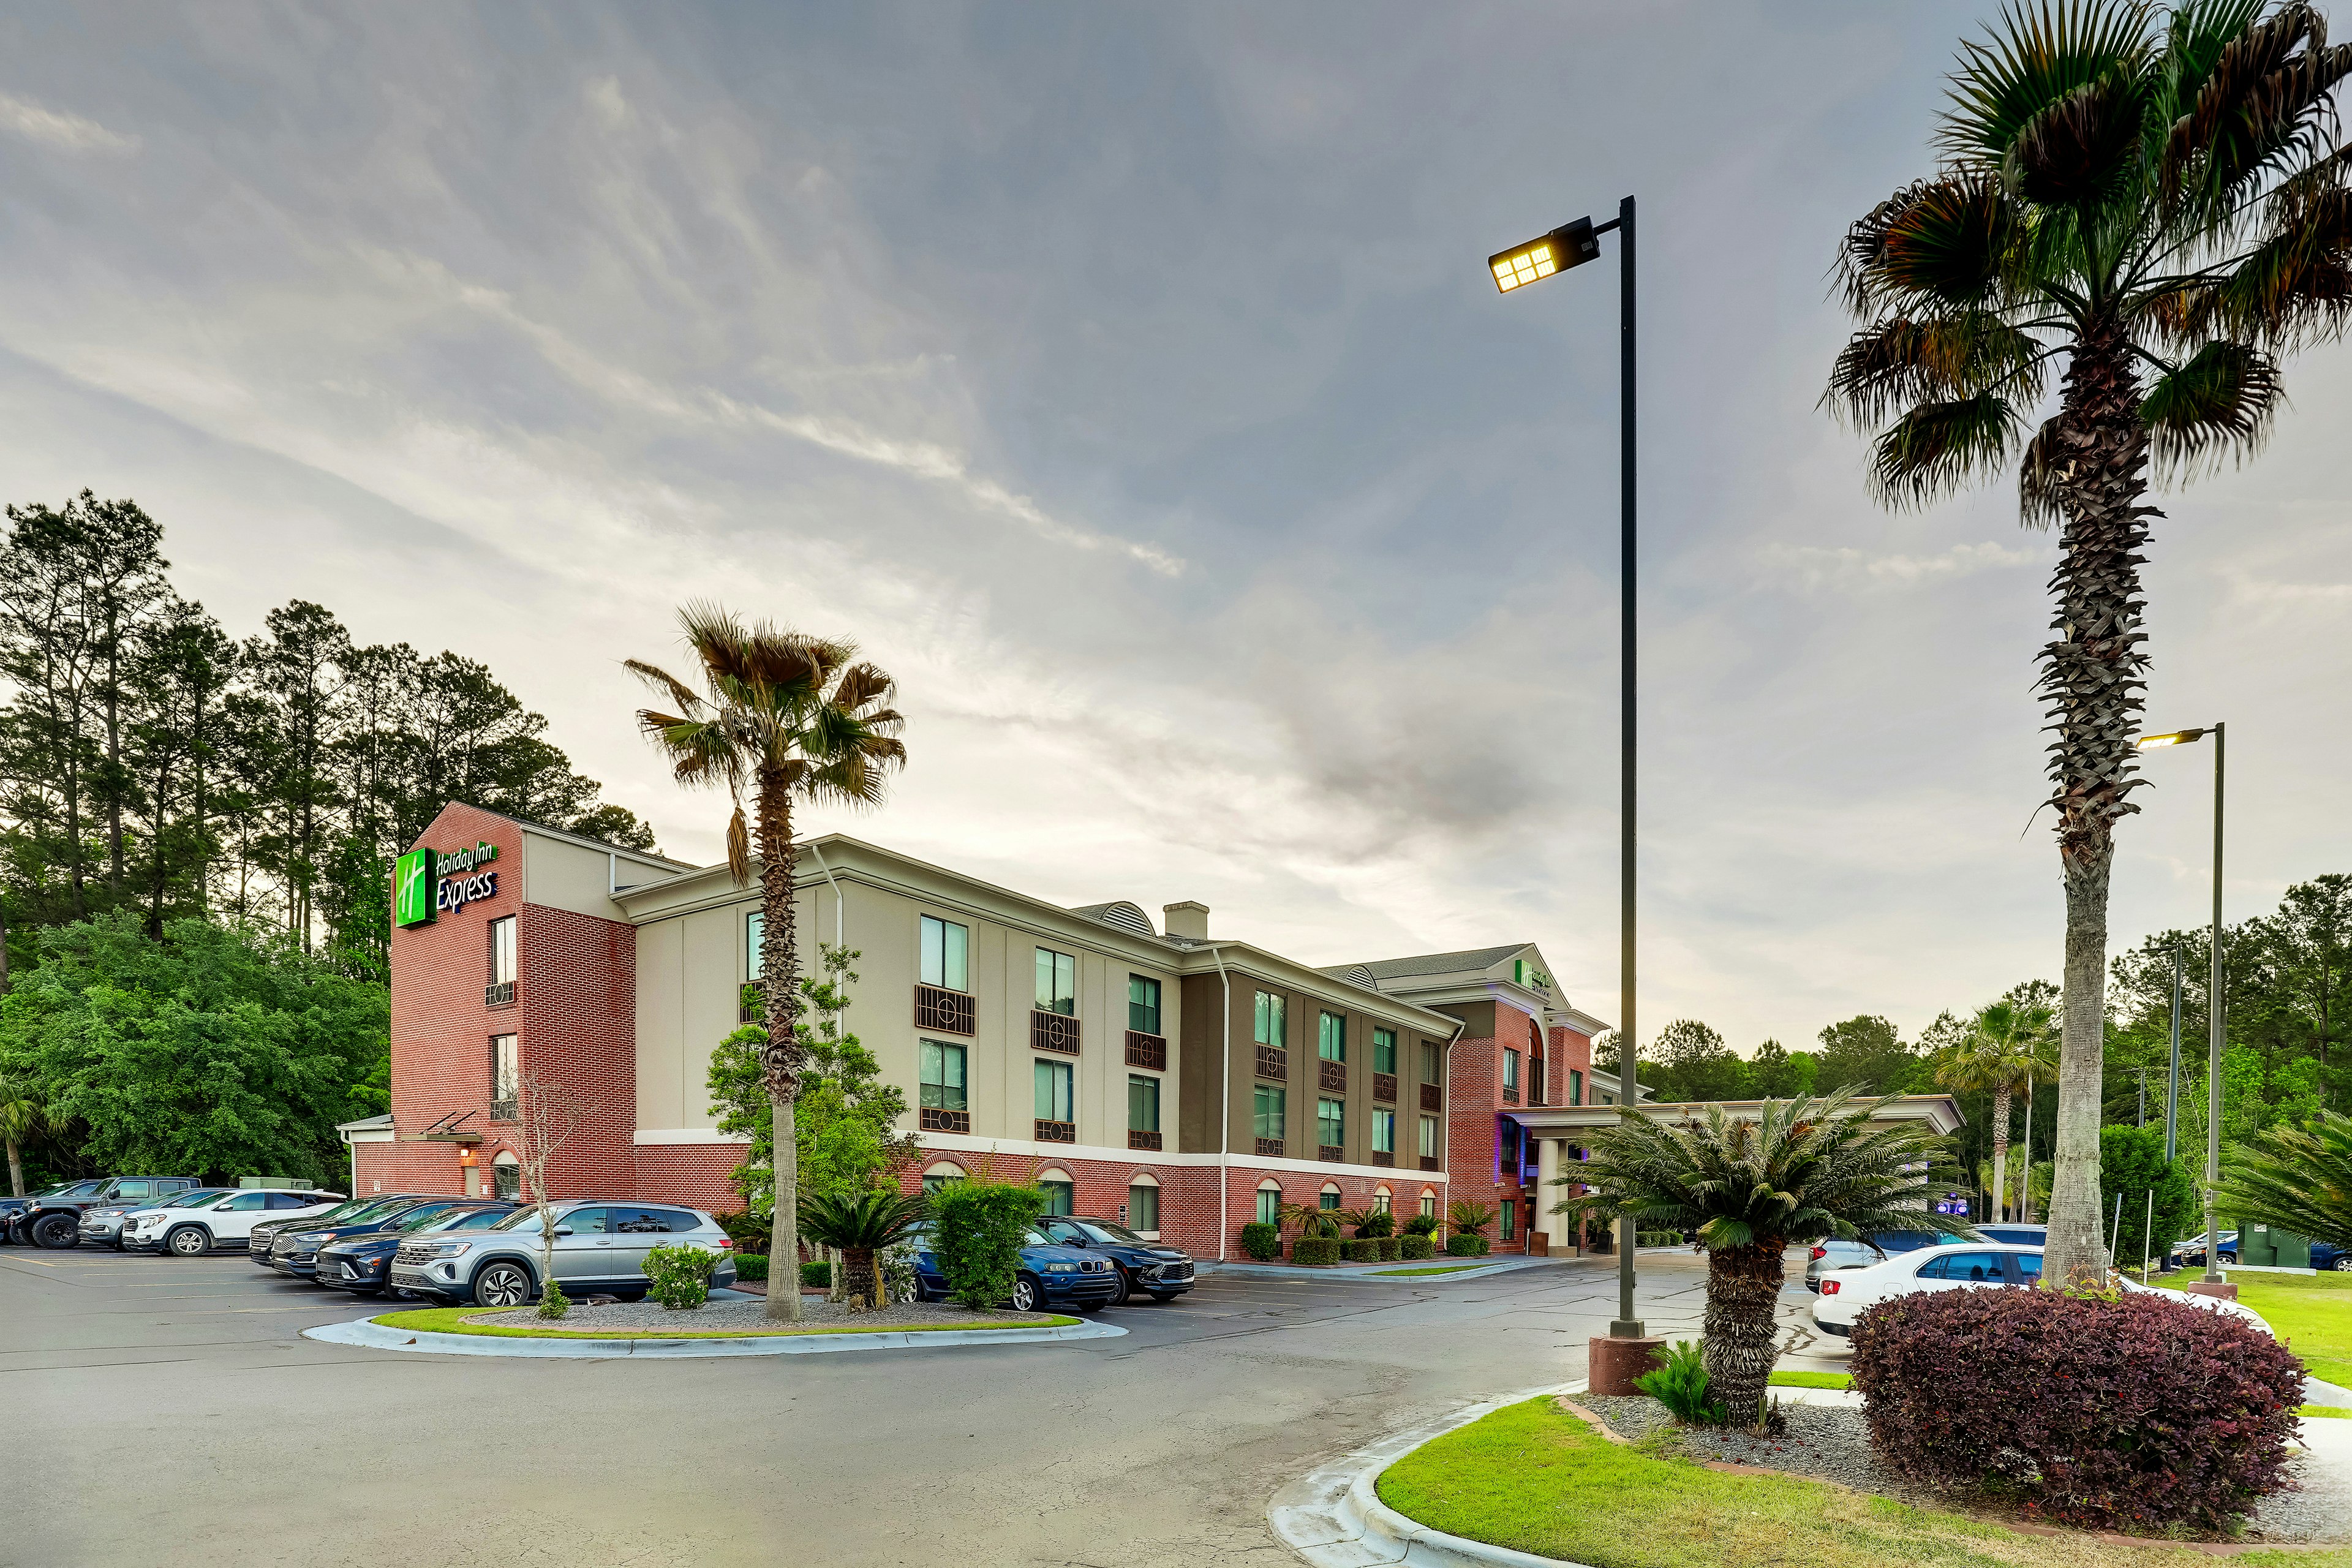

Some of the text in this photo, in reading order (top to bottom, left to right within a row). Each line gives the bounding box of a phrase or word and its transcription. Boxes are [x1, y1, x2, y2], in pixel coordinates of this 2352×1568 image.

[436, 840, 492, 876] Holiday Inn
[436, 871, 492, 914] Express
